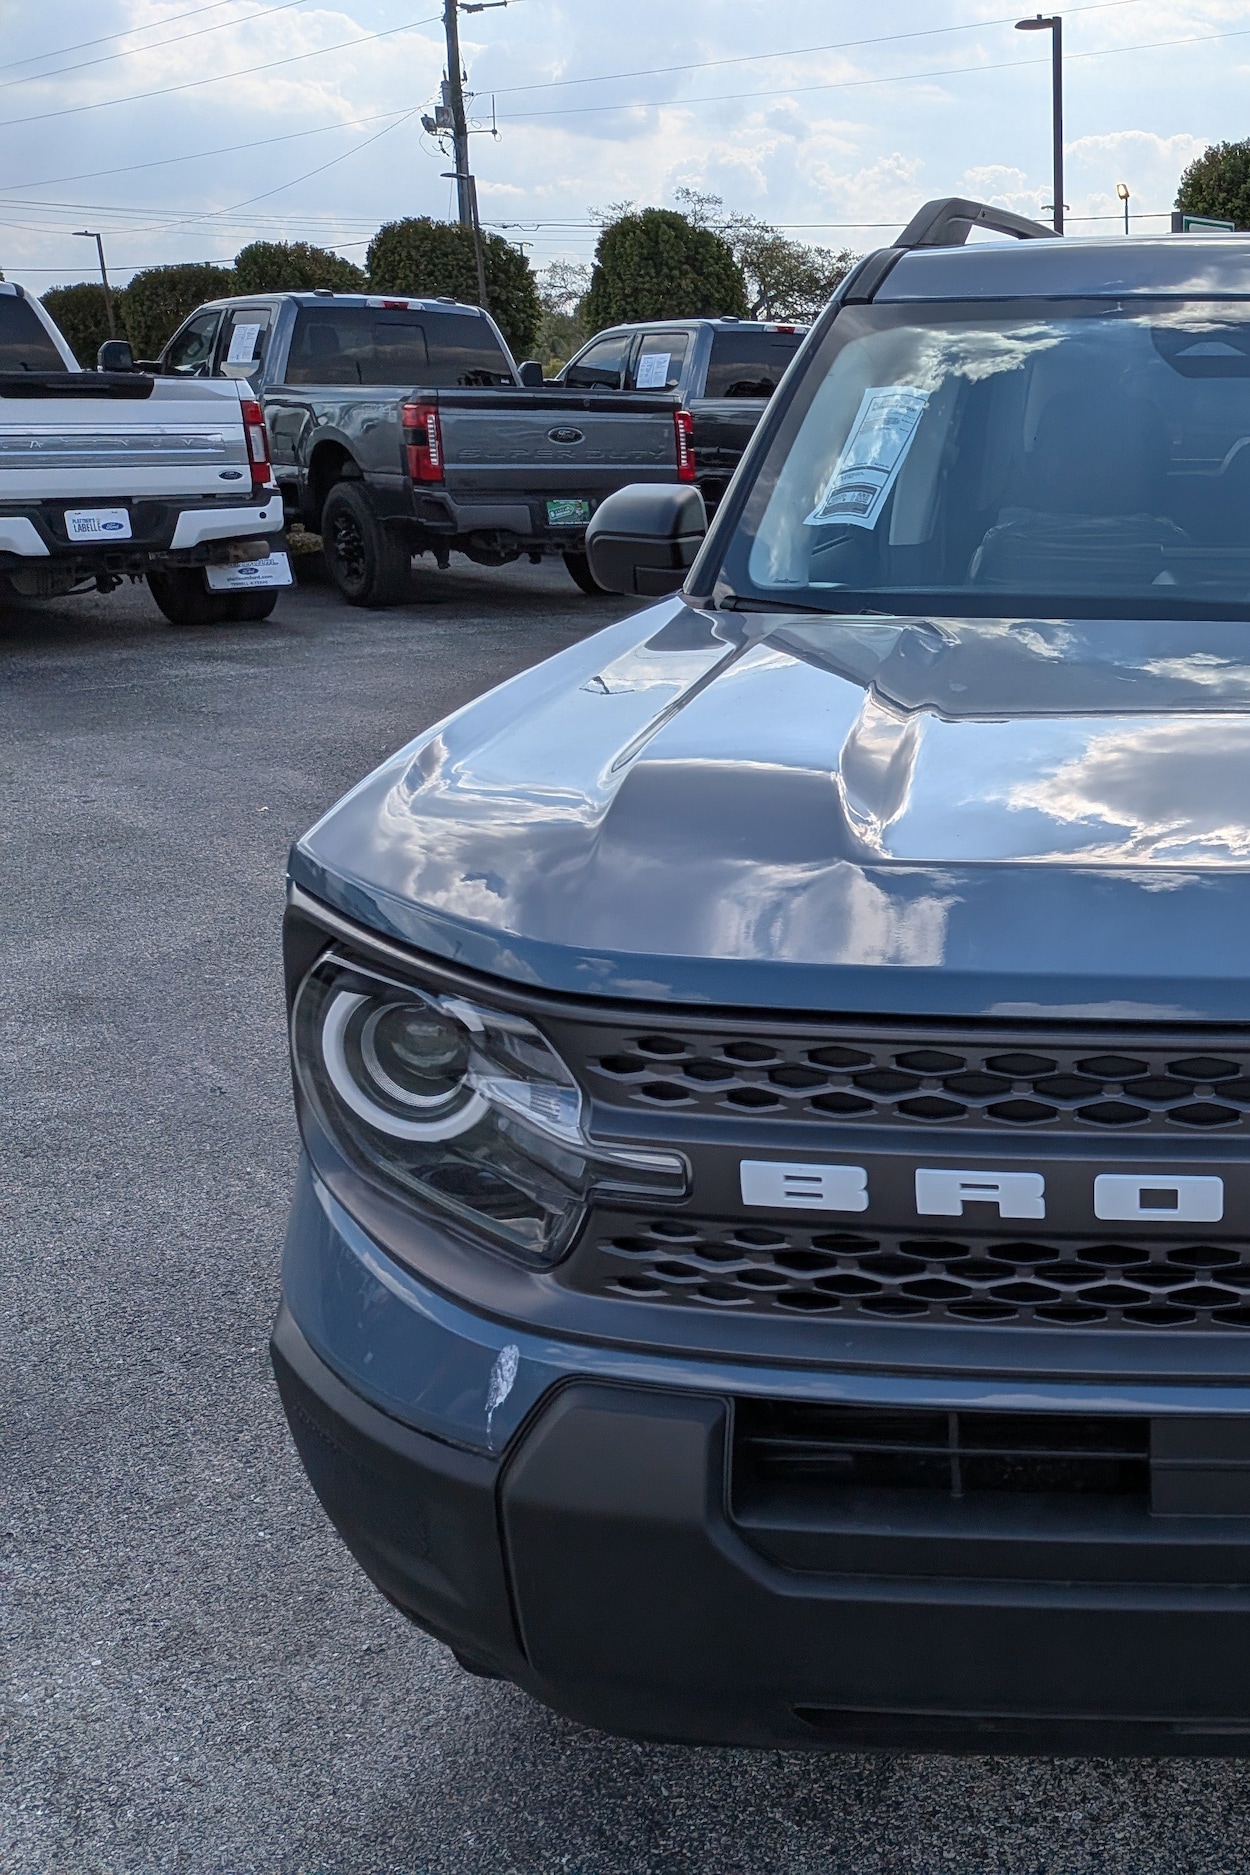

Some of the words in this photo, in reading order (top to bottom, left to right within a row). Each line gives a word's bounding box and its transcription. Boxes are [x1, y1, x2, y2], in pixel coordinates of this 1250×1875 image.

[458, 449, 577, 459] SUPER
[586, 449, 666, 460] DUTY
[73, 523, 102, 533] LABELLE
